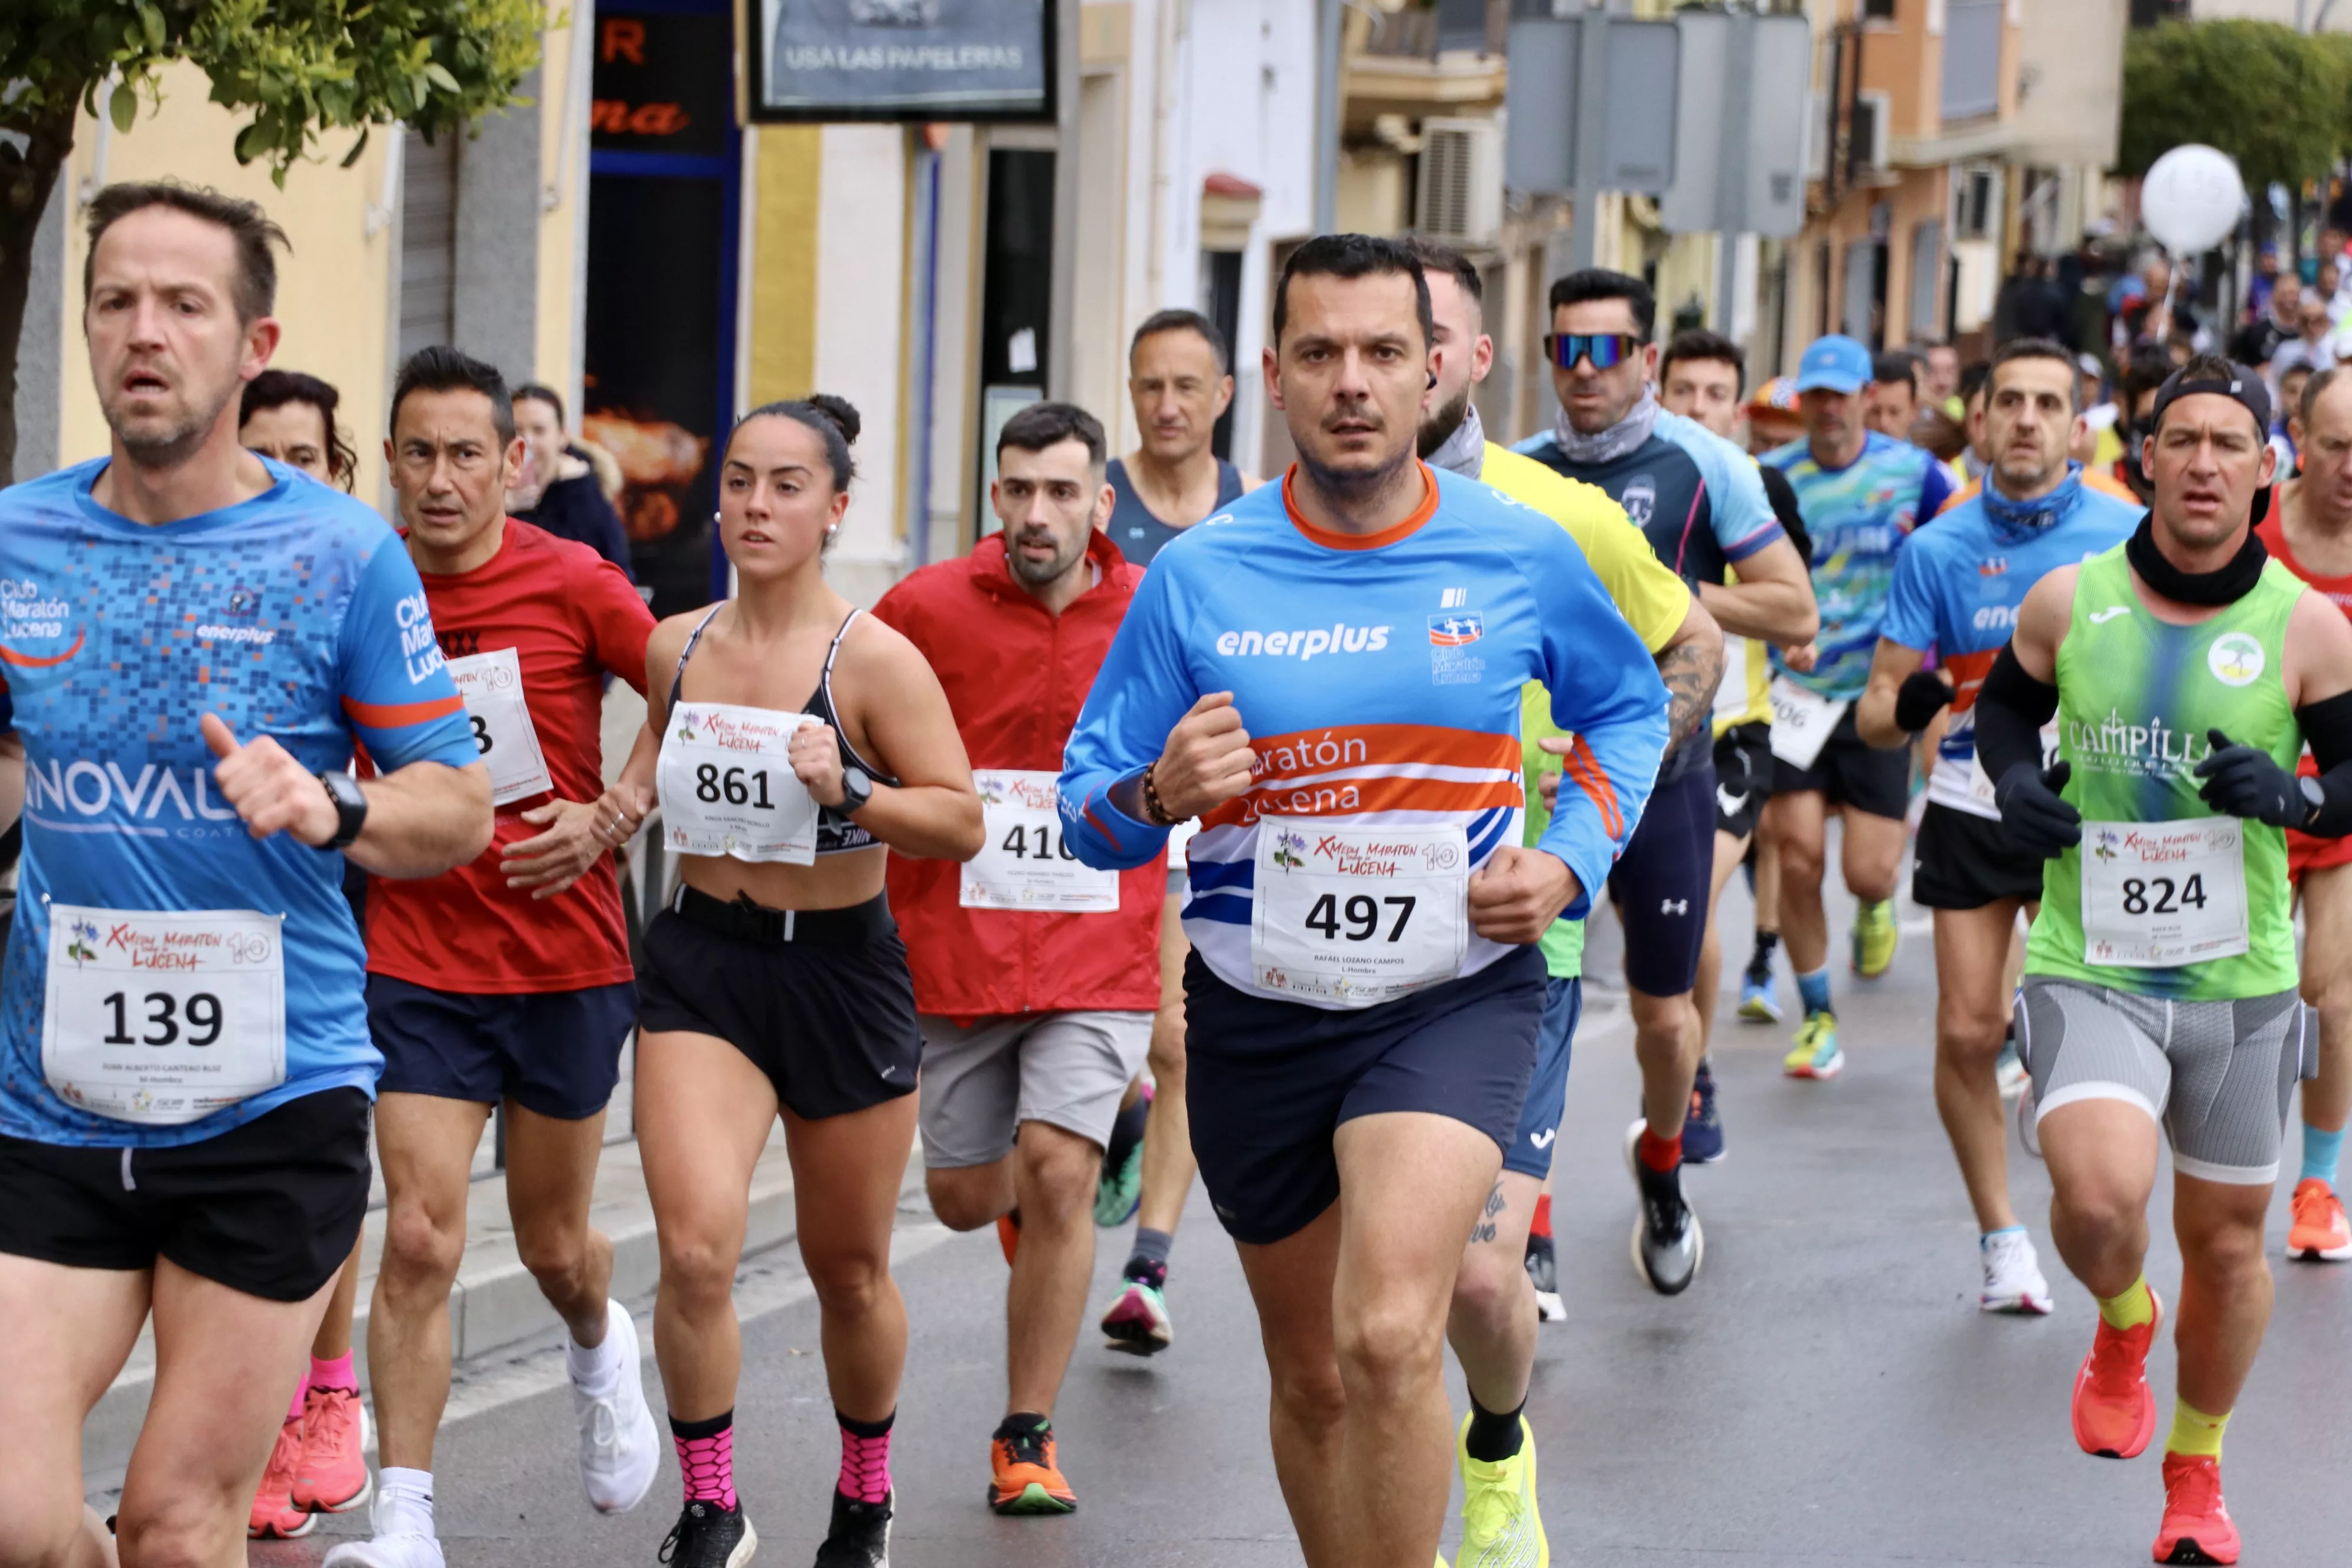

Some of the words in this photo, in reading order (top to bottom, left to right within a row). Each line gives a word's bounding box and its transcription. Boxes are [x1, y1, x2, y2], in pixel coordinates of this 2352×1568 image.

[786, 45, 835, 70] USA
[838, 45, 884, 70] LAS
[888, 44, 1023, 70] PAPELERAS
[0, 579, 37, 599] Club
[1, 597, 69, 618] Maratón
[4, 620, 62, 639] Lucena
[197, 623, 275, 644] enerplus
[1216, 623, 1389, 661] enerplus
[718, 732, 766, 753] LUCENA
[696, 763, 775, 810] 861
[842, 828, 871, 847] NIKE
[2142, 848, 2186, 862] LUCENA
[1338, 857, 1403, 878] LUCENA
[2123, 873, 2207, 915] 824
[1305, 894, 1416, 943] 497
[132, 949, 207, 972] LUCENA
[1314, 955, 1341, 963] RAFAEL
[1373, 957, 1404, 965] CAMPOS
[102, 991, 223, 1047] 139
